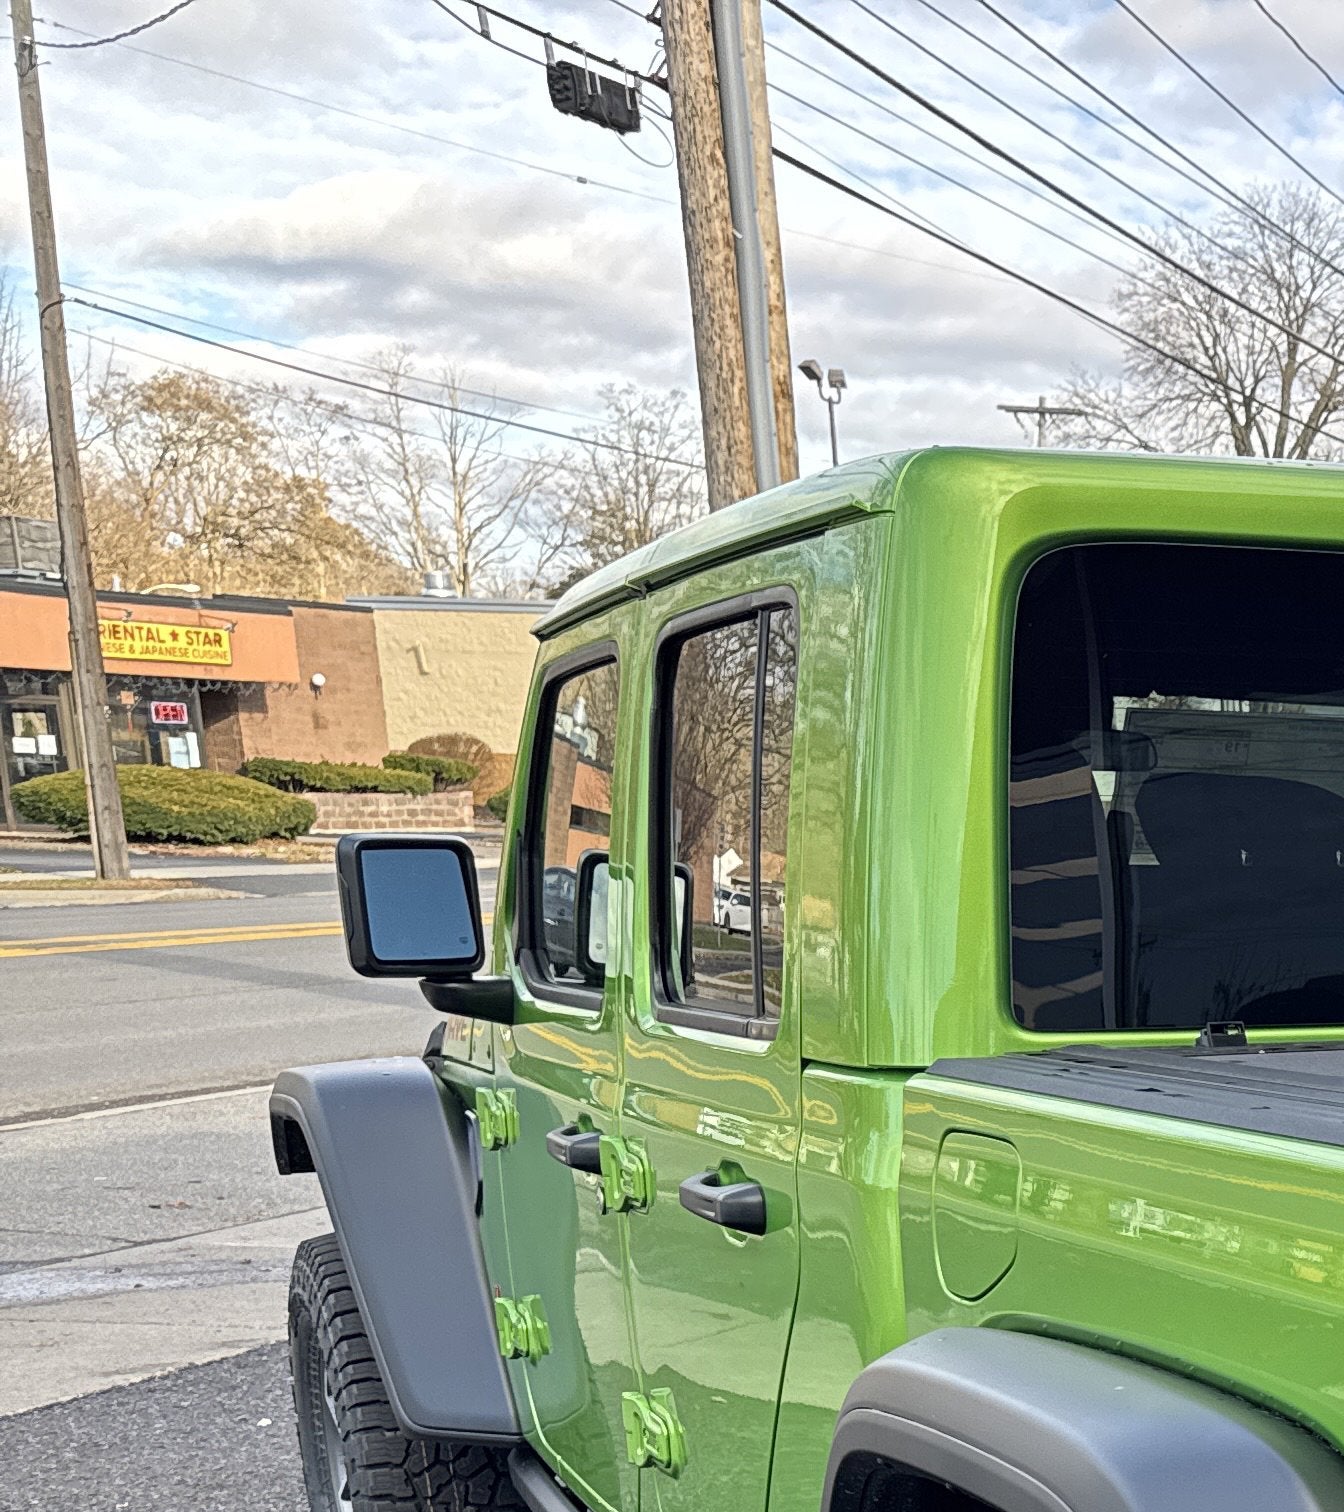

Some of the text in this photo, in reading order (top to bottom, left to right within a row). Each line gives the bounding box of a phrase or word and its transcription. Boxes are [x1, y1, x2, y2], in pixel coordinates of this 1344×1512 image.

[98, 624, 223, 648] RIENTAL STAR
[128, 645, 136, 656] &
[139, 645, 190, 659] JAPANESE
[192, 650, 229, 662] CUISINE
